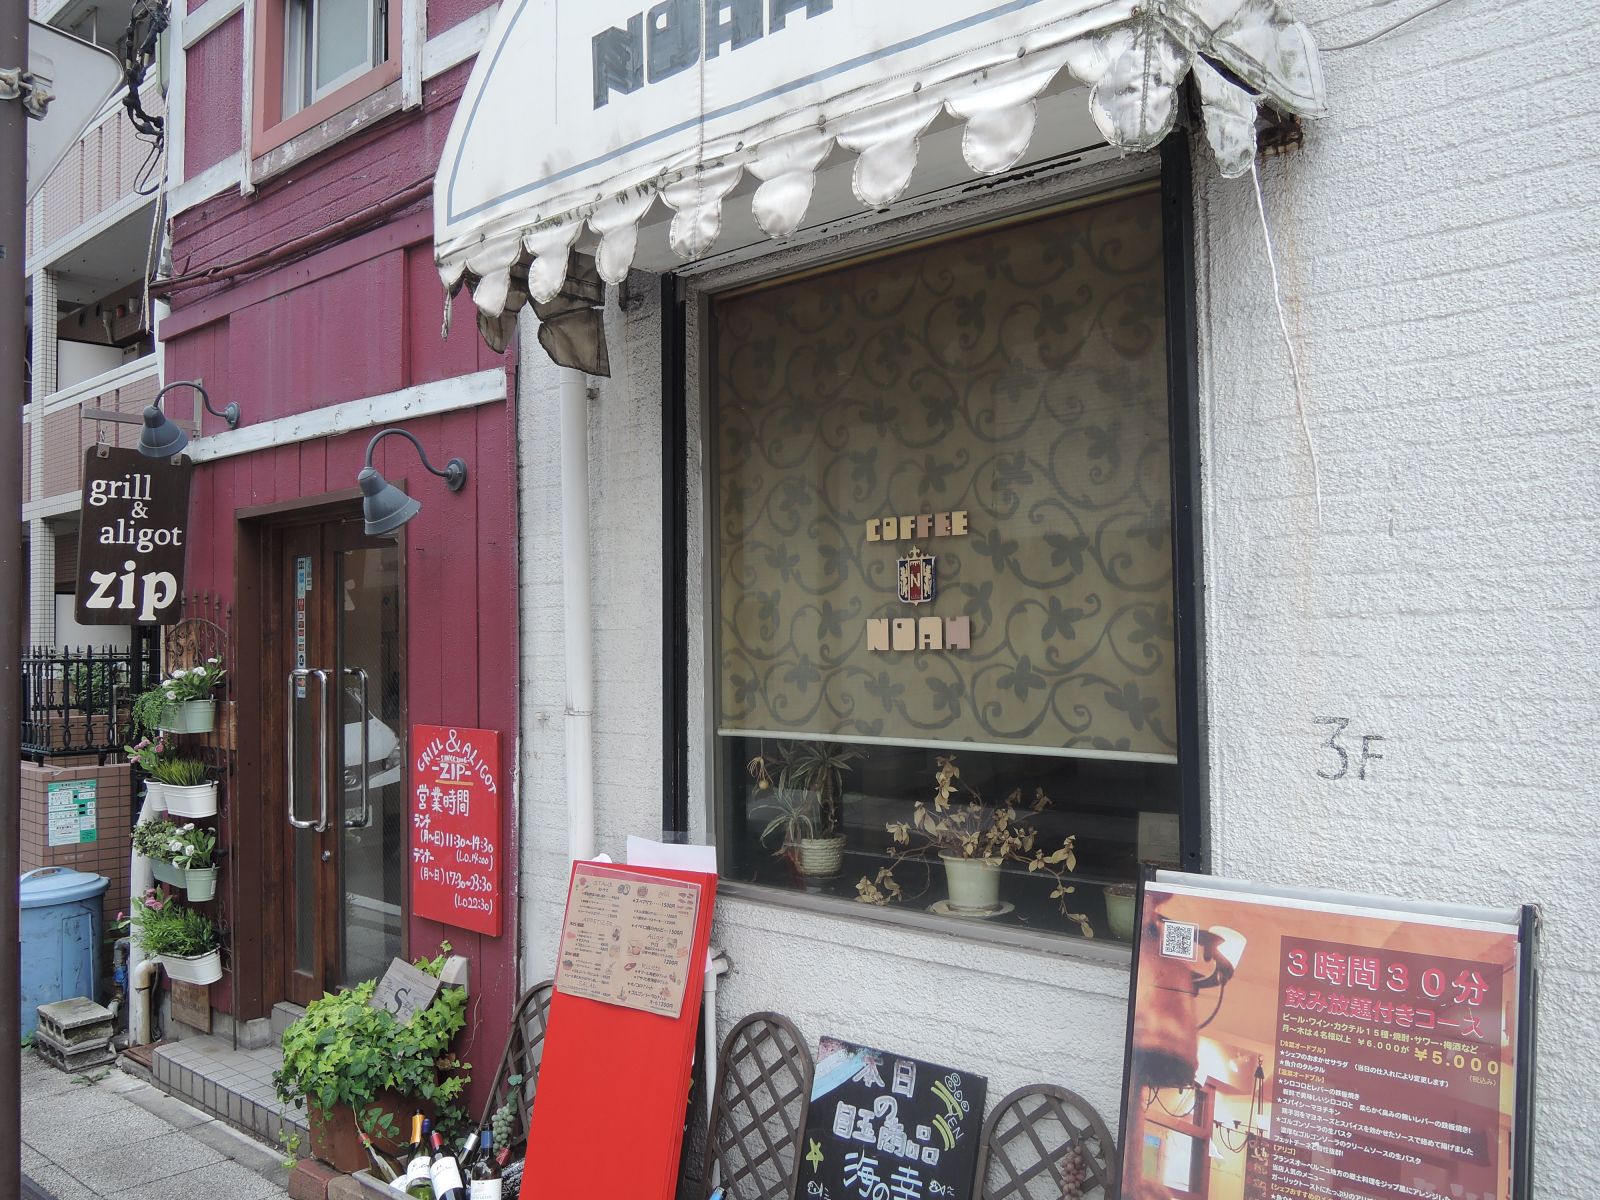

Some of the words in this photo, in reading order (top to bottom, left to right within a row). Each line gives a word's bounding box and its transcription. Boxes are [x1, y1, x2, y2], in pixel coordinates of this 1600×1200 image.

[89, 474, 152, 506] grill
[131, 500, 149, 519] &
[866, 511, 968, 541] COFFEE
[100, 518, 182, 553] aligot
[85, 560, 178, 621] zip
[910, 573, 921, 588] N
[417, 737, 444, 772] GRILL
[445, 729, 461, 753] &
[462, 742, 497, 795] ALIGOT
[416, 784, 470, 816] 営業時間
[1287, 949, 1489, 1006] 3時間30分
[1284, 985, 1485, 1039] 飲み放題付きコース
